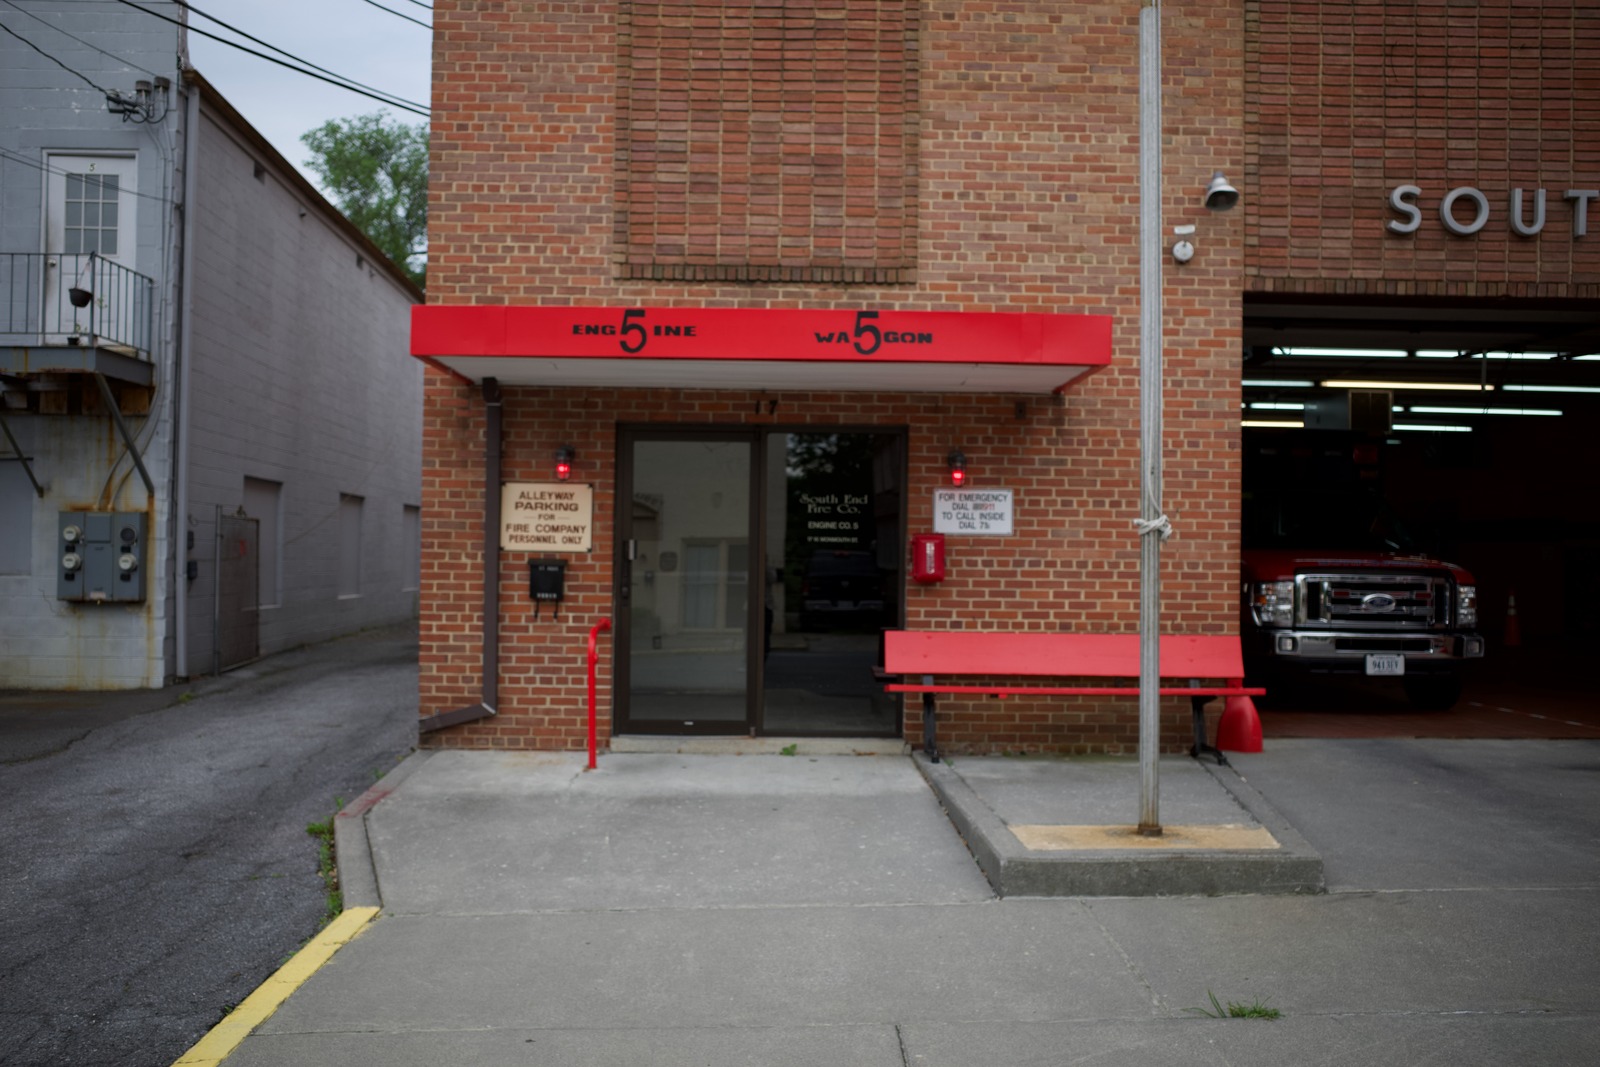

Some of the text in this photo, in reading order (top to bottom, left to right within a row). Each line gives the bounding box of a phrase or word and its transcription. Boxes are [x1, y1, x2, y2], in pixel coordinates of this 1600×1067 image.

[89, 163, 96, 172] 5
[1386, 184, 1600, 238] SOUT
[619, 309, 647, 354] 5
[853, 311, 881, 356] 5
[519, 491, 575, 500] ALLEYWAY
[799, 493, 869, 504] South End
[938, 493, 1008, 502] FOR EMERGENCY
[514, 502, 579, 512] PARKING
[807, 504, 861, 514] Fire Co.
[952, 502, 970, 511] DIAL
[942, 511, 1005, 521] TO CALL INSIDE
[505, 524, 587, 534] FIRE COMPANY
[807, 521, 838, 530] ENGINE
[959, 521, 976, 529] DIAL
[509, 535, 583, 545] PERSONNEL ONLY
